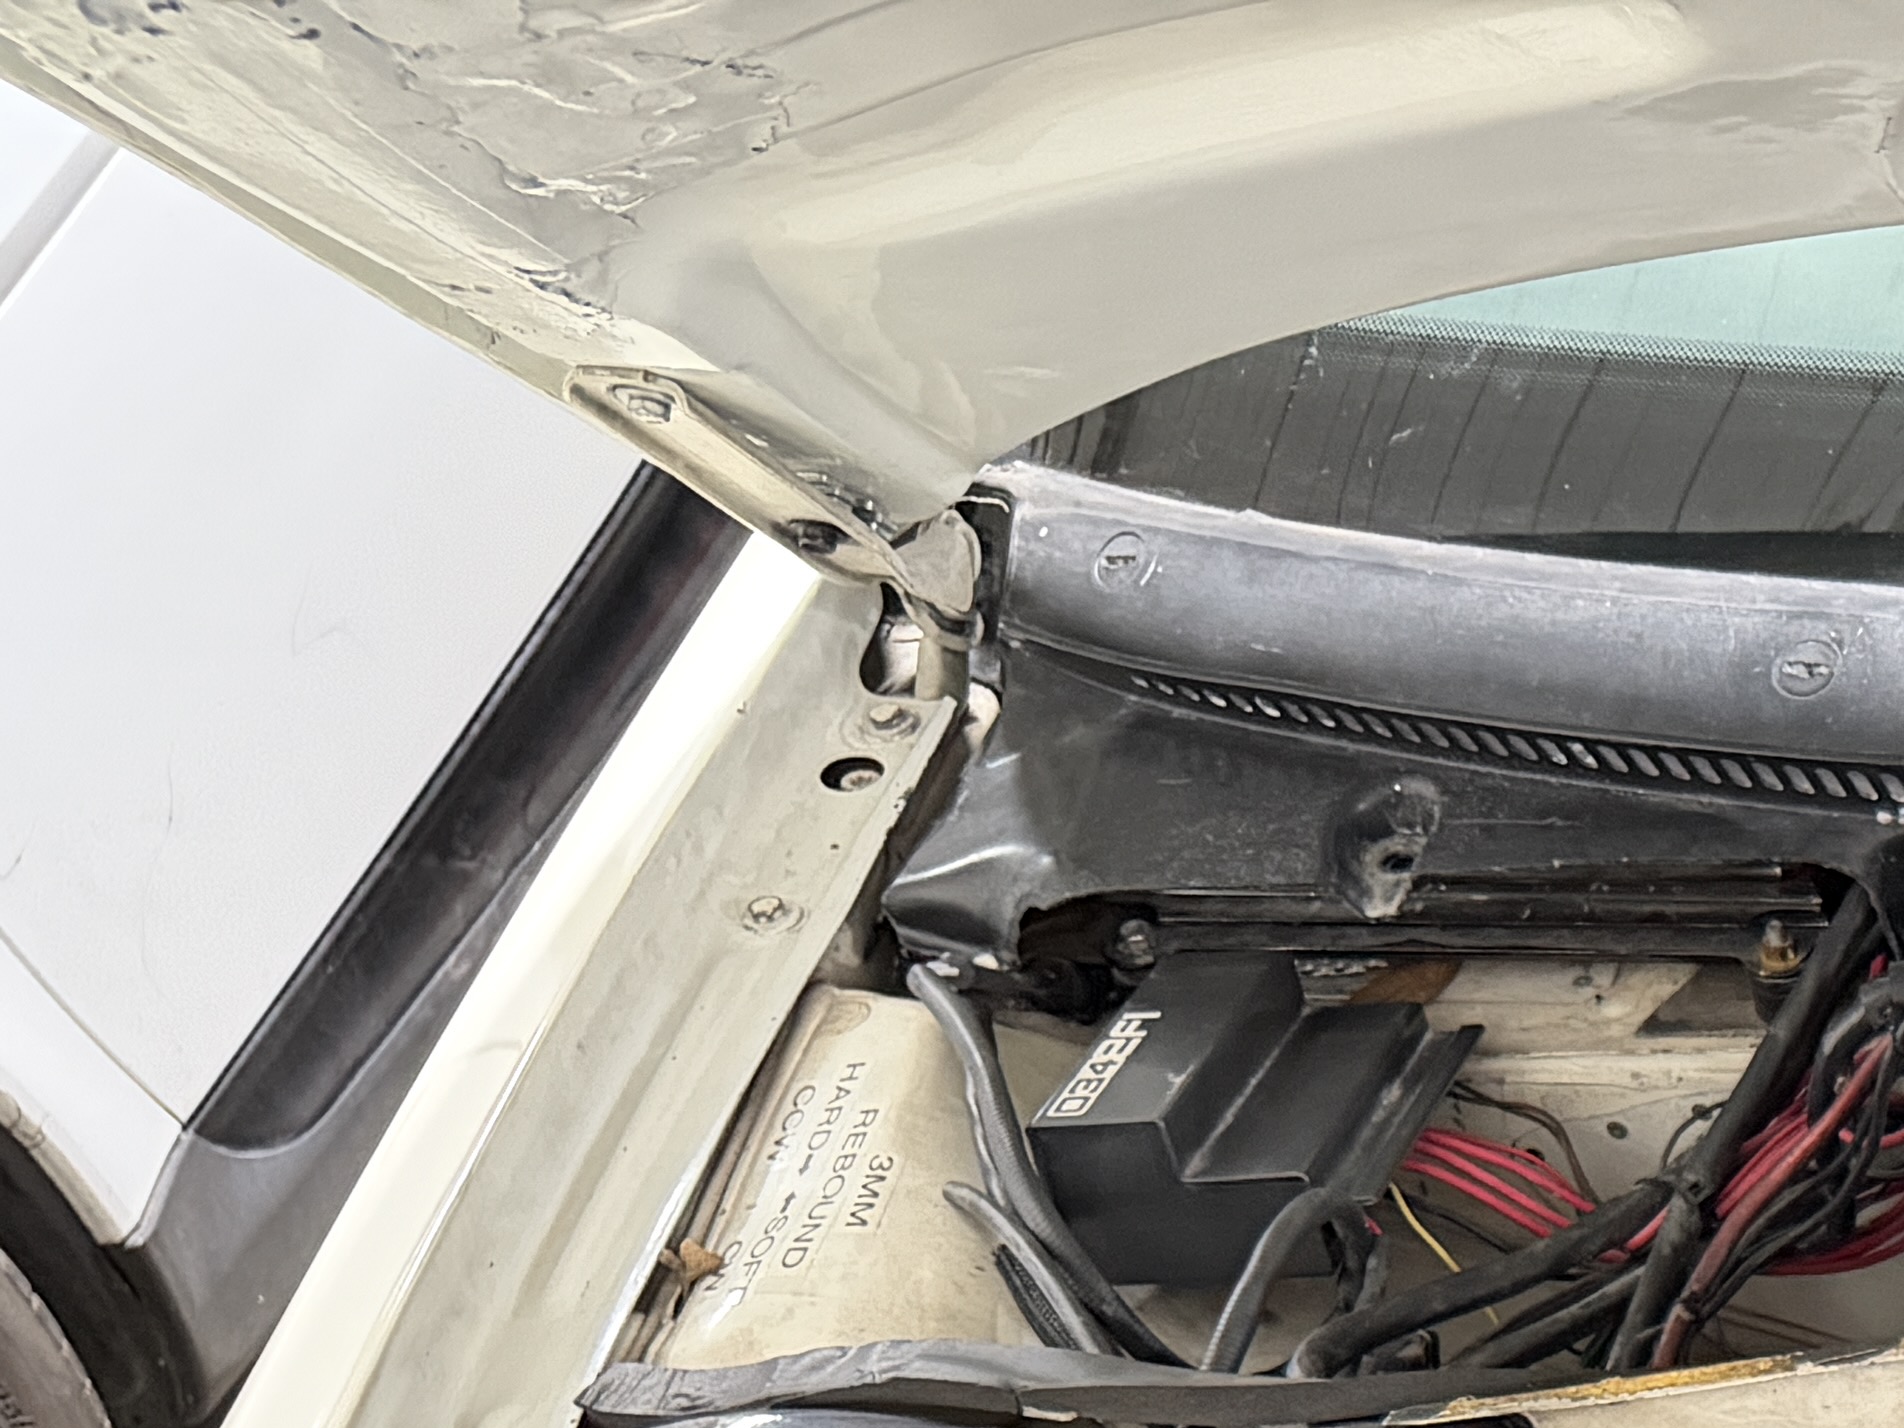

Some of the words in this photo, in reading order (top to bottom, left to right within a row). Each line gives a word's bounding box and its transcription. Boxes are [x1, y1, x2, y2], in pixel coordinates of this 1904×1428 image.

[767, 1084, 816, 1161] CCW
[806, 1061, 866, 1151] HARD
[782, 1109, 880, 1269] REBOUND
[845, 1155, 894, 1228] 3MM
[731, 1214, 790, 1305] SOFT
